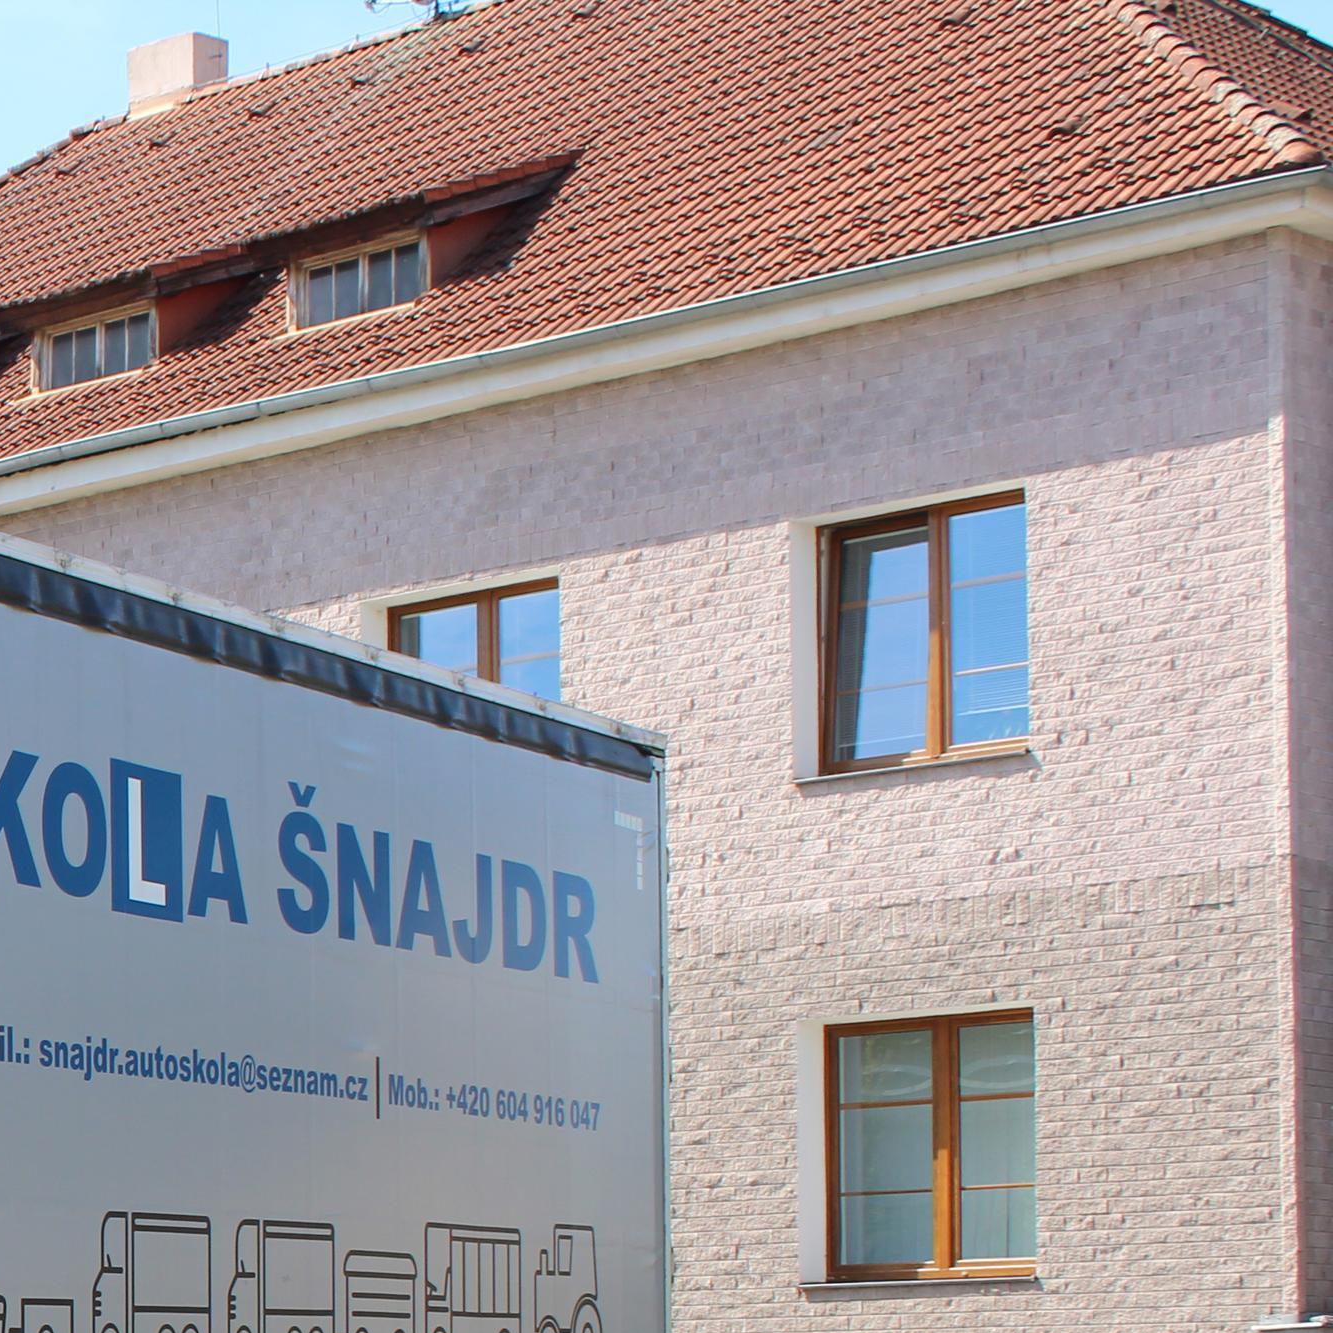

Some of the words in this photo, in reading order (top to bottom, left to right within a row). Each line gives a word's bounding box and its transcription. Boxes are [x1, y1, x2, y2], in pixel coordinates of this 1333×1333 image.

[277, 779, 600, 984] ŠNAJDR
[39, 1034, 369, 1102] snajdr.autoskola@seznam.cz
[388, 1072, 440, 1112] Mob.:
[446, 1082, 491, 1119] +420
[496, 1087, 529, 1122] 604
[534, 1093, 565, 1128] 916
[570, 1098, 601, 1132] 047
